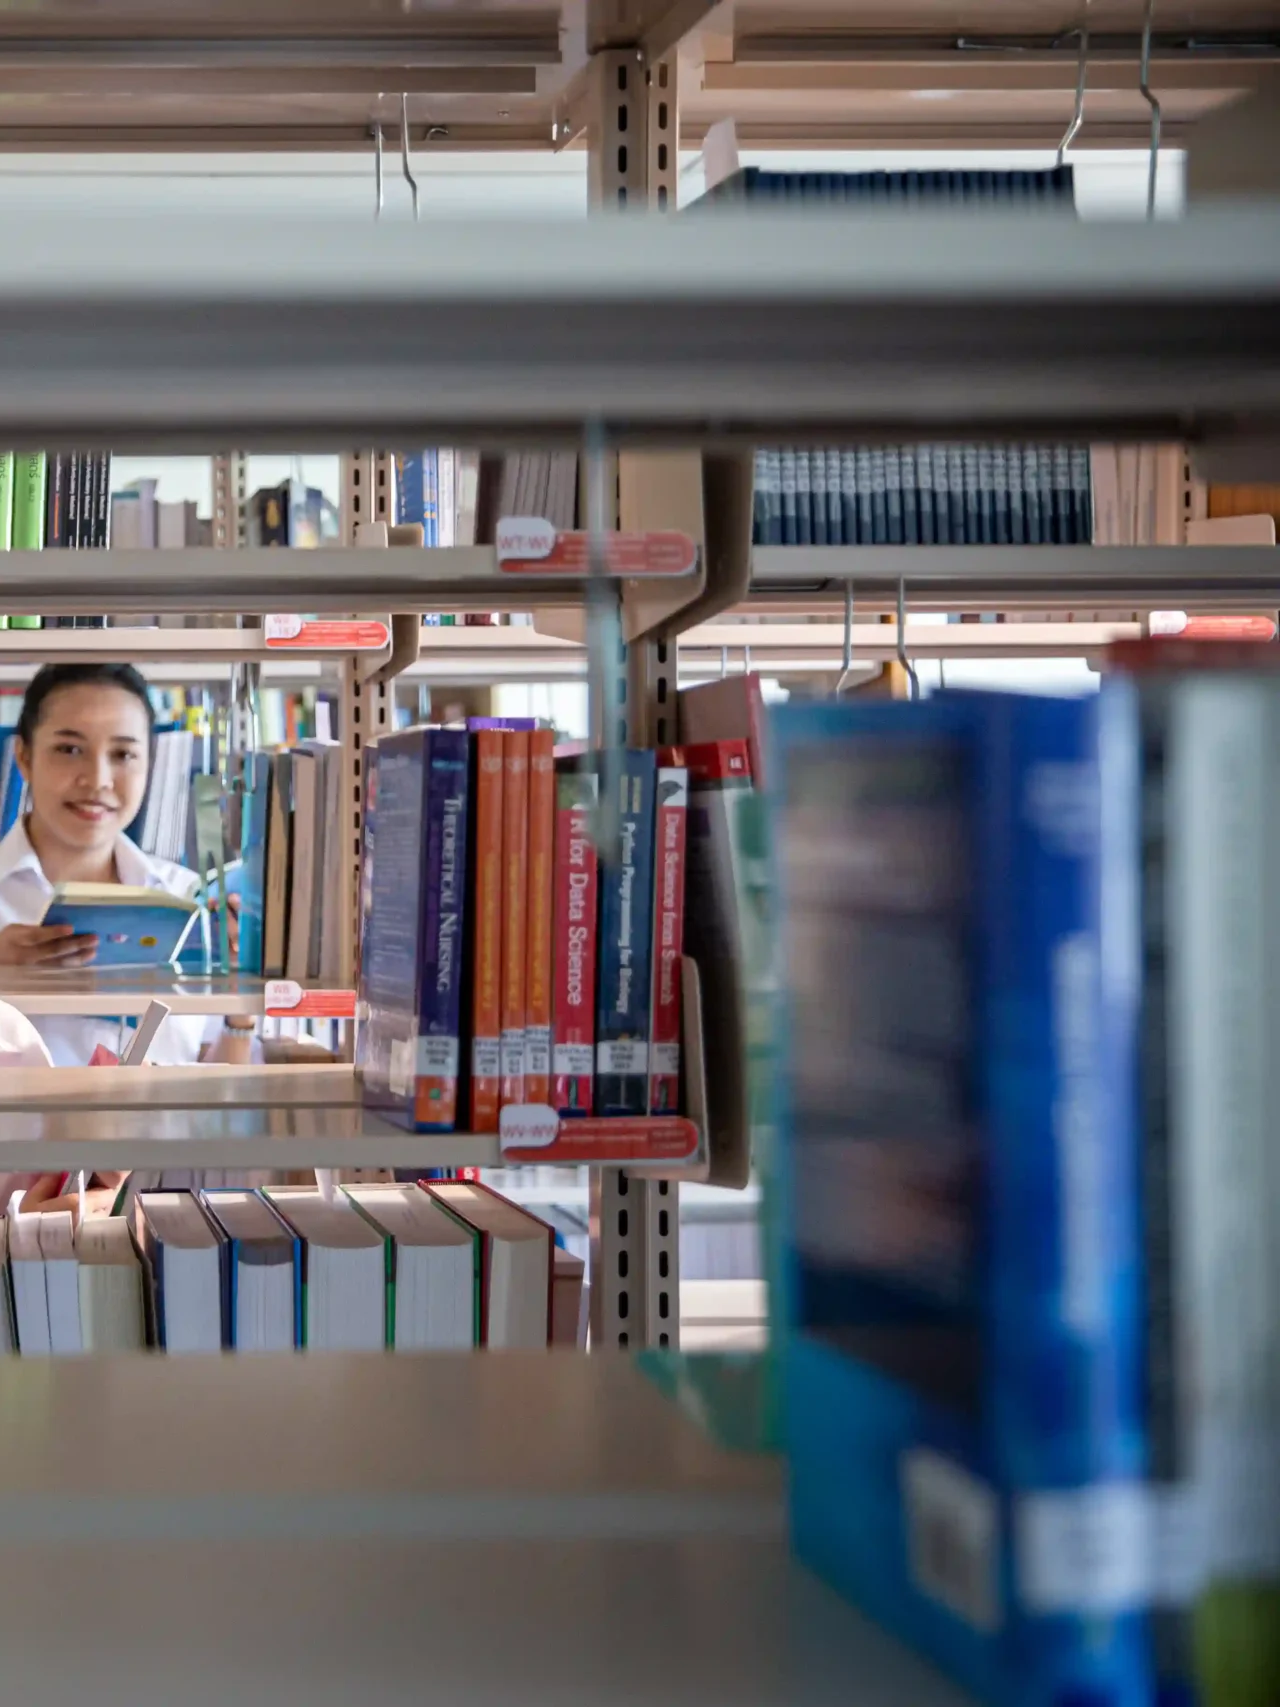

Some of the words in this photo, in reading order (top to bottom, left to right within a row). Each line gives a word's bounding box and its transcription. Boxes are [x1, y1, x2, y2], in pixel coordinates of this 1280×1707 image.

[569, 838, 590, 866] for
[662, 813, 679, 849] Data
[568, 872, 589, 922] Data
[660, 851, 679, 908] Science
[435, 912, 458, 992] NURSING
[660, 911, 677, 946] from
[566, 926, 588, 1006] Science
[659, 948, 676, 1006] Scratch
